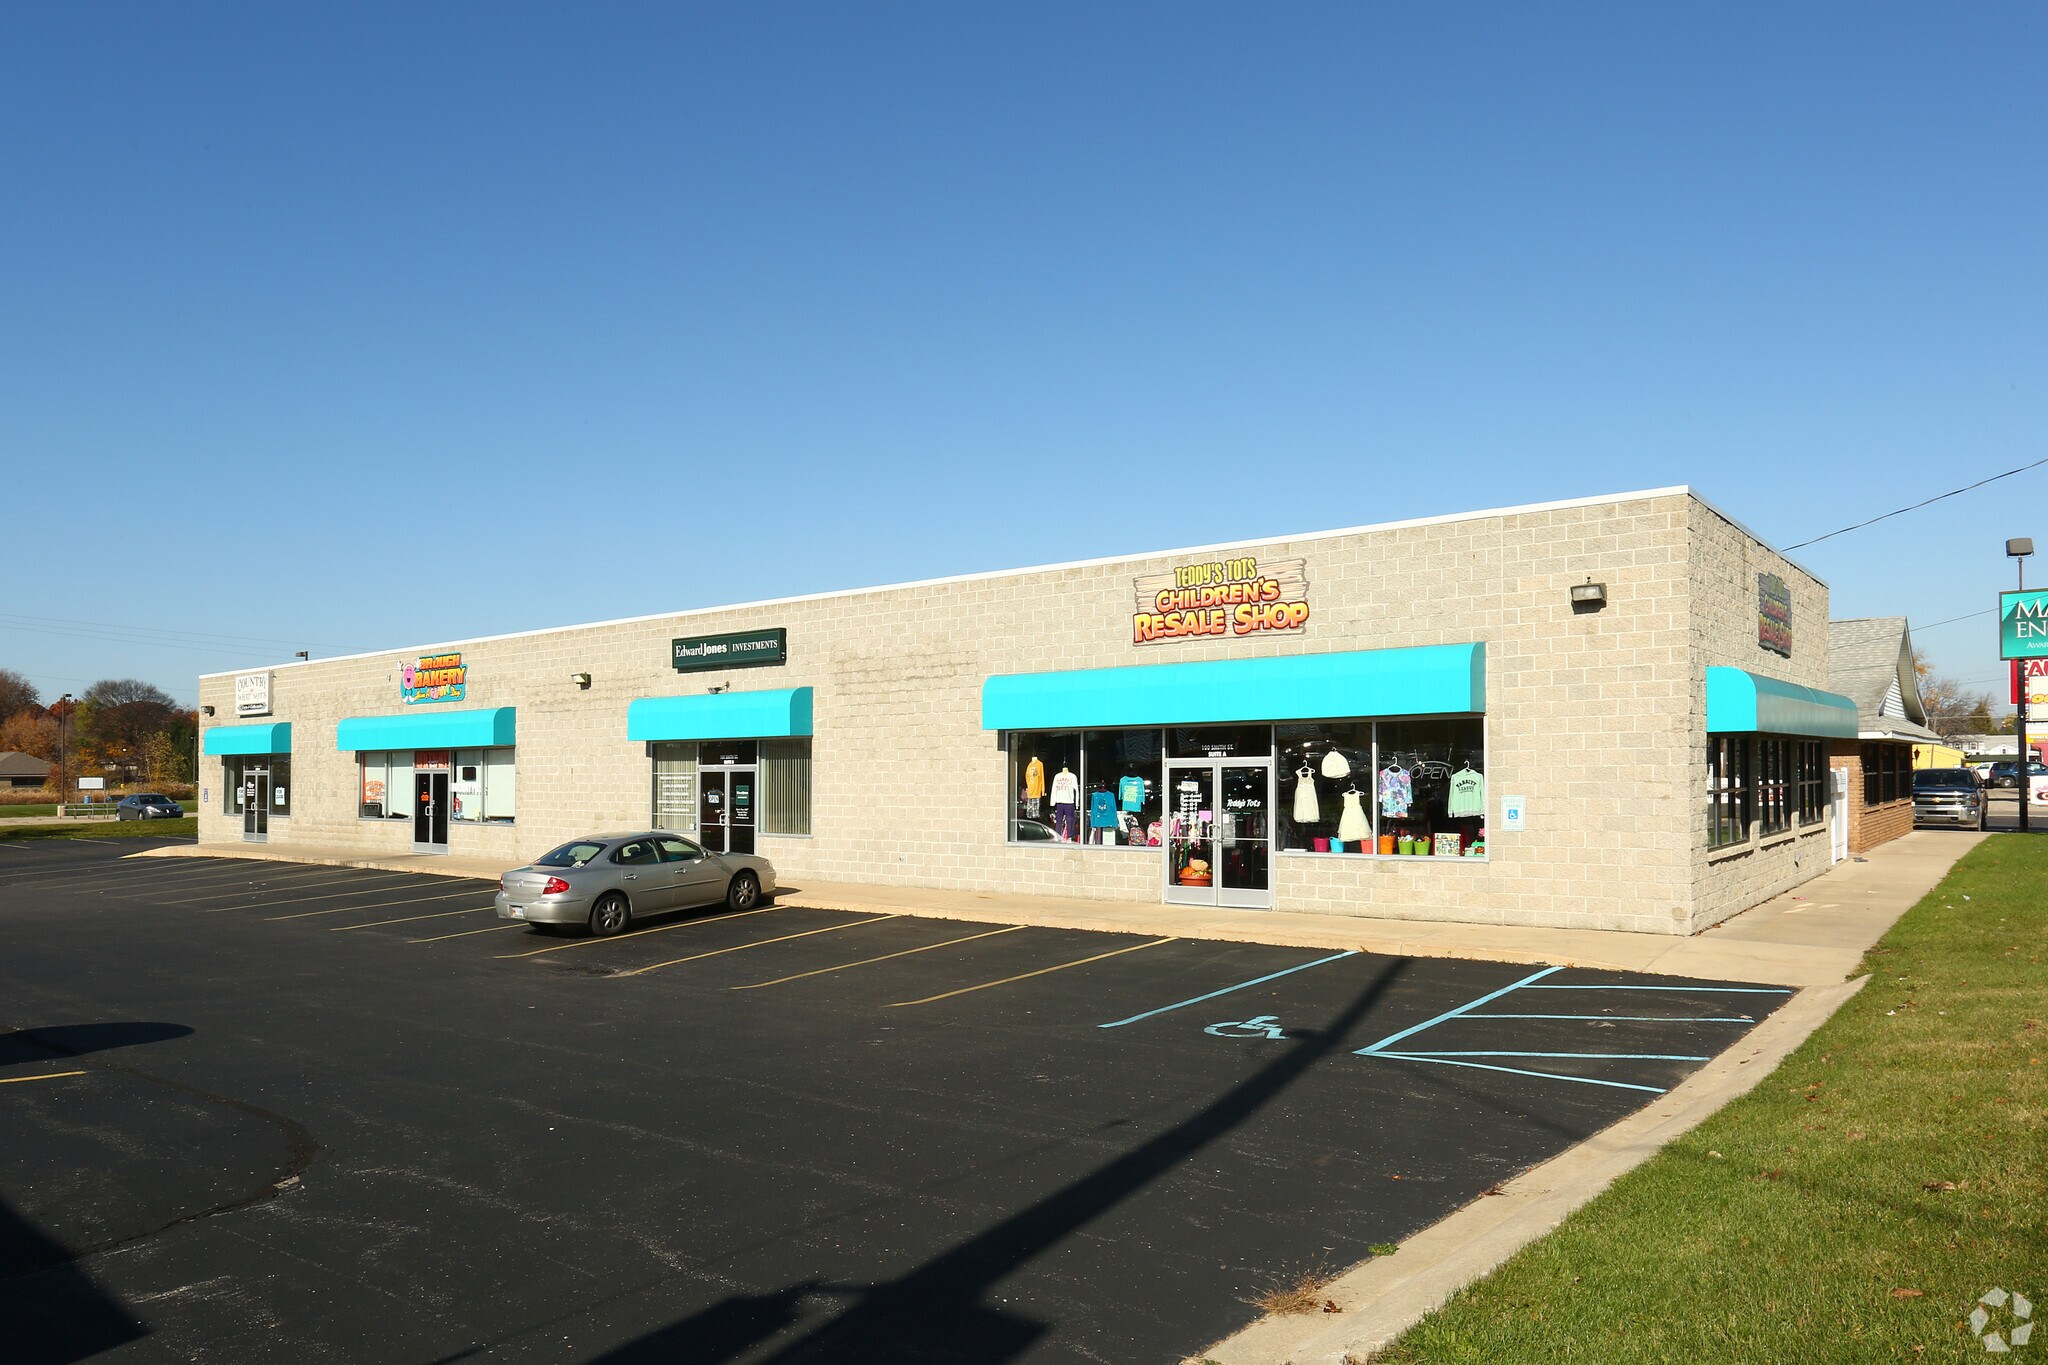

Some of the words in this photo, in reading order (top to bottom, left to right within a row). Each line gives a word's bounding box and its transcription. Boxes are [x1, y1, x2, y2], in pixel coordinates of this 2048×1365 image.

[1174, 562, 1223, 588] TEDDY'S
[1226, 557, 1257, 581] TOTS
[1155, 576, 1281, 613] CHILDREN'S
[1133, 608, 1226, 643] RESALE
[1233, 601, 1310, 635] SHOP
[732, 639, 778, 652] INVESTMENTS
[413, 667, 465, 689] BAKERY
[1410, 765, 1455, 780] OPEN
